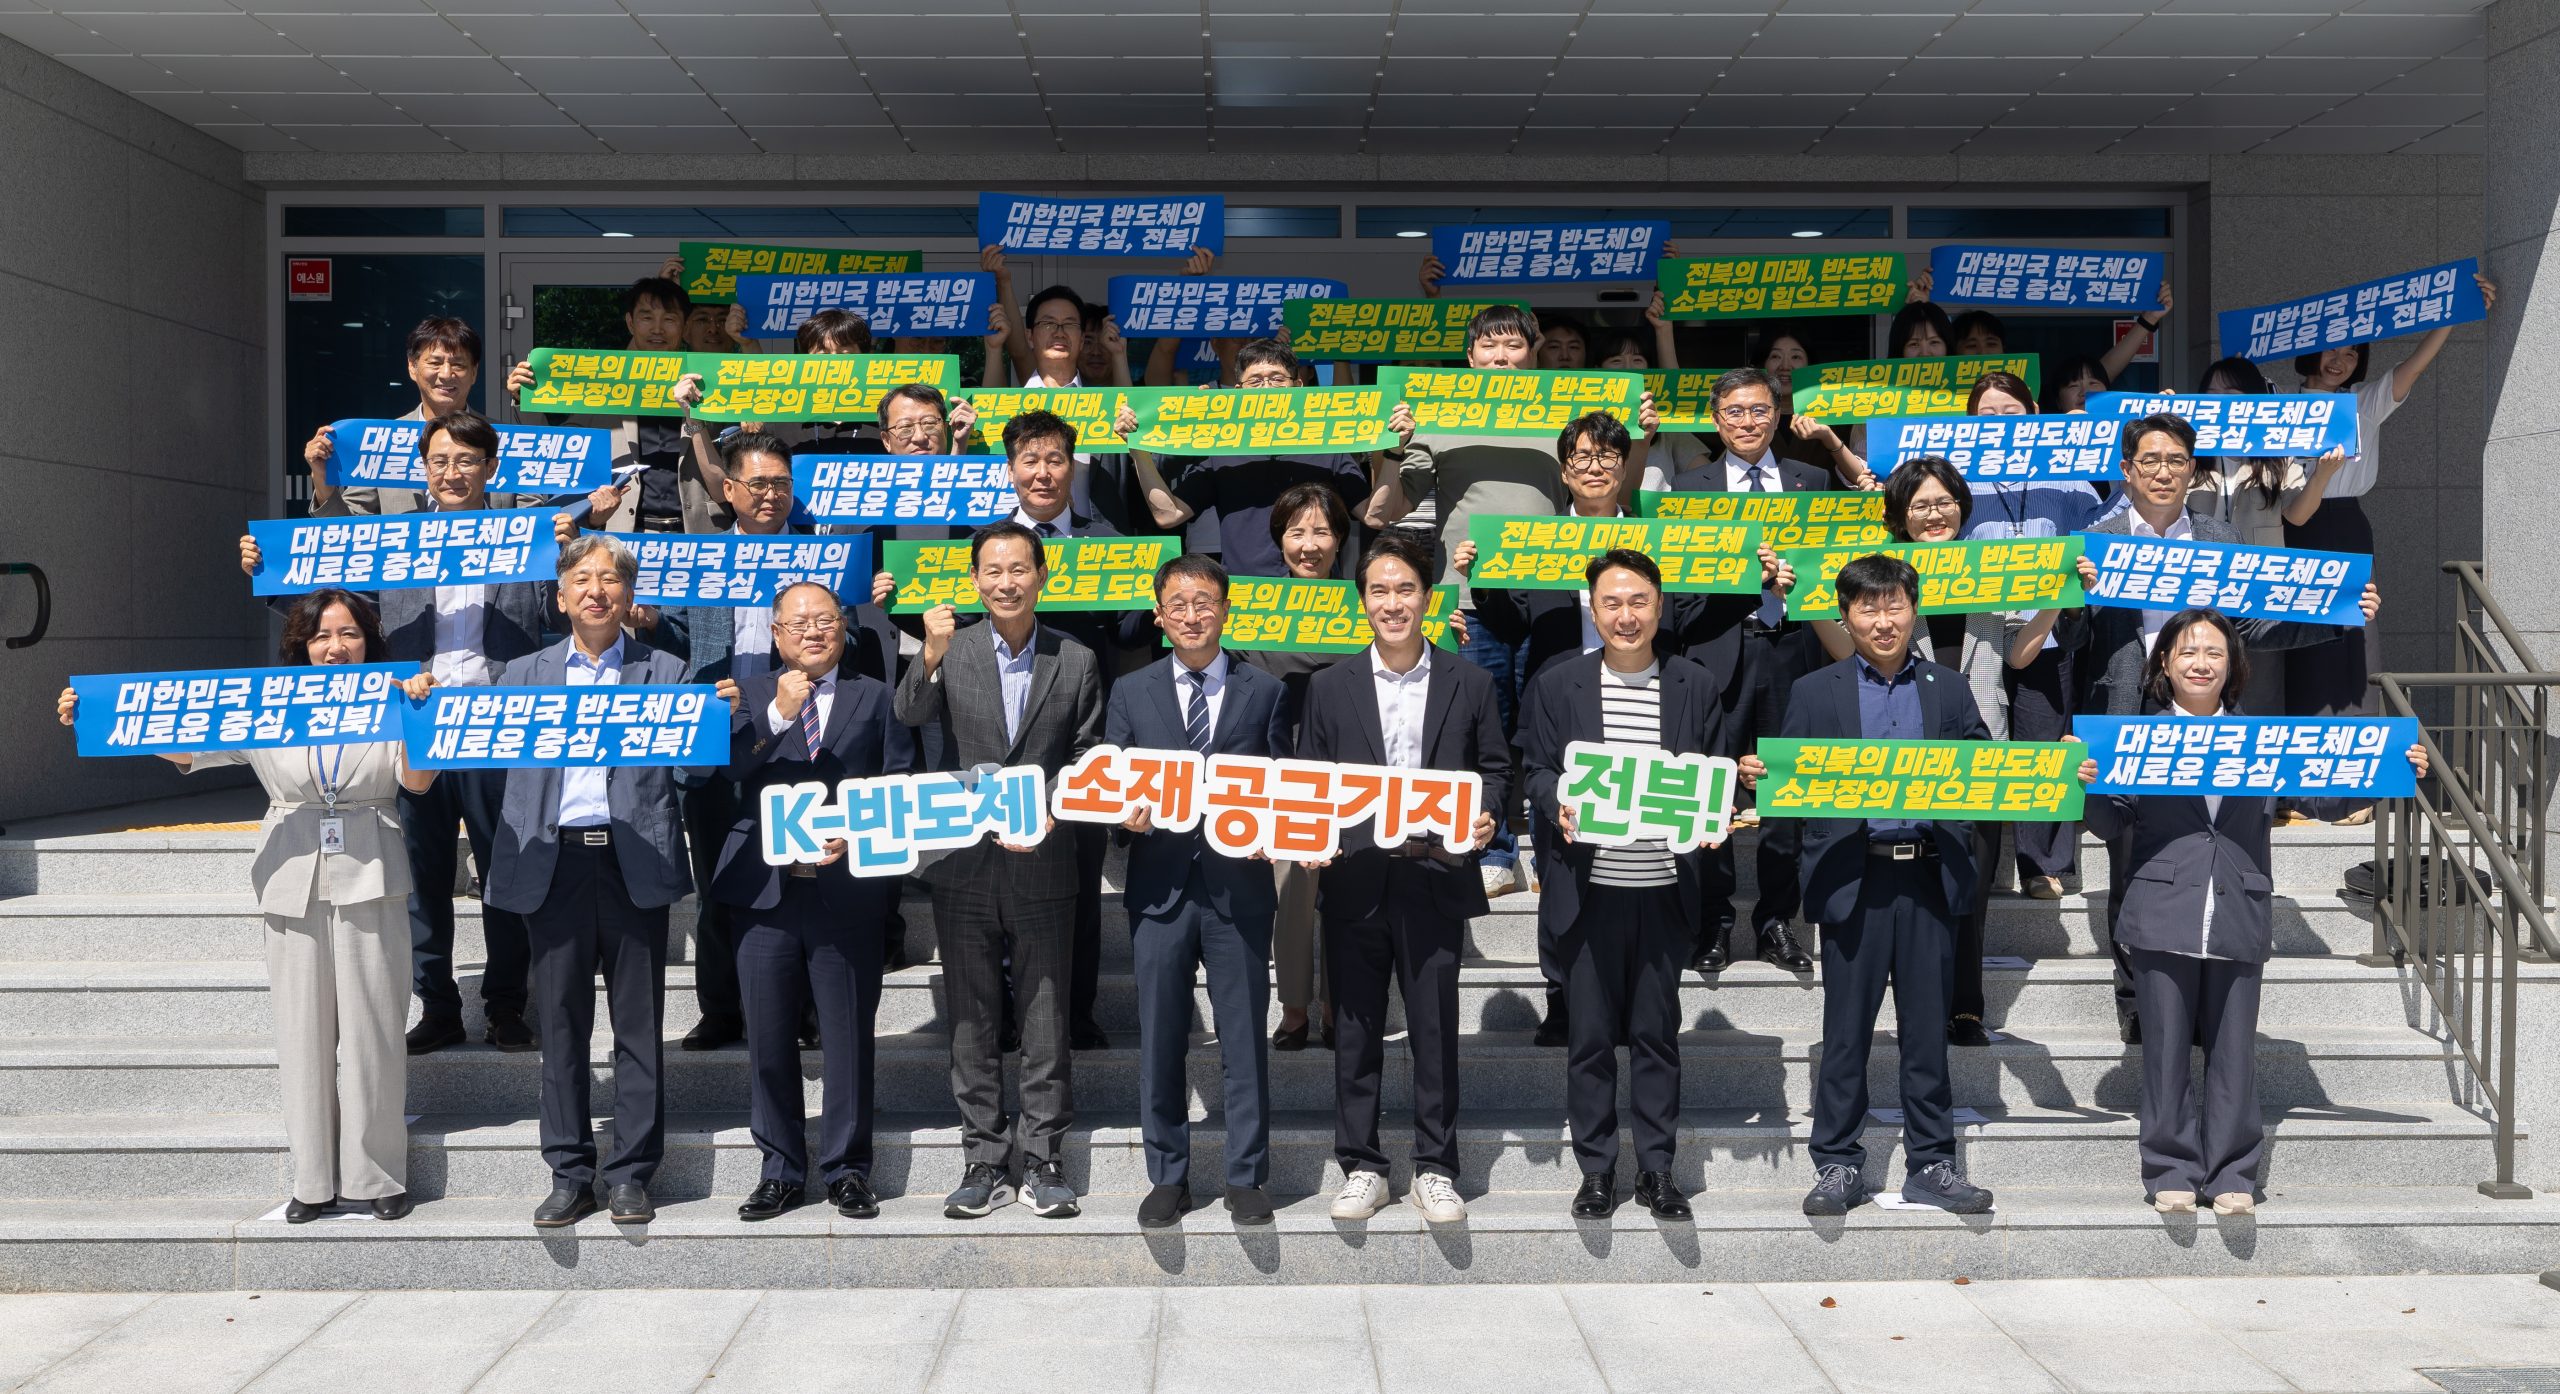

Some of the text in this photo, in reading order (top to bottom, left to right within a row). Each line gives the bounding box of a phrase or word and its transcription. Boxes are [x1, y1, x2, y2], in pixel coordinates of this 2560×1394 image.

[1007, 202, 1205, 226] 대한민국 반도체의
[999, 226, 1199, 253] 새로운 중심, 전북!
[1460, 227, 1652, 254] 대한민국 반도체의
[705, 249, 776, 274] 전북의
[837, 255, 908, 274] 반도체
[1453, 251, 1646, 279] 새로운 중심, 전북!
[1686, 257, 1893, 286] 전북의 미래, 반도체
[1956, 252, 2148, 280] 대한민국 반도체의
[296, 272, 325, 284] 에스원
[688, 275, 737, 297] 소부
[768, 279, 975, 306] 대한민국 반도체의
[1950, 277, 2141, 304] 새로운 중심, 전북!
[1131, 282, 1229, 305] 대한민국
[1670, 283, 1896, 312] 소부장의 힘으로 도약
[2250, 268, 2457, 335] 대한민국 반도체의
[762, 305, 969, 334] 새로 심, 전북!
[1124, 307, 1197, 330] 새로운
[1204, 307, 1258, 334] 중심,
[1309, 303, 1382, 327] 전북의
[1387, 304, 1436, 331] 미래,
[2244, 294, 2454, 359] 새로운 중심, 전북!
[1292, 330, 1469, 352] 소부장의 힘으로
[549, 355, 626, 380] 전북의
[717, 360, 945, 388] 전북의 미래, 반도체
[1819, 364, 1892, 391] 전북의
[1896, 361, 1948, 389] 미래,
[531, 381, 635, 407] 소부장의
[700, 389, 806, 414] 소부장의
[1405, 373, 1630, 404] 전북의 미래, 반도체
[1644, 374, 1720, 400] 래, 반도
[1048, 393, 1106, 420] 미래,
[1157, 395, 1235, 421] 전북의
[1238, 393, 1297, 422] 미래,
[1303, 391, 1382, 417] 반도체
[1410, 401, 1491, 428] 부장의
[1494, 403, 1572, 429] 힘으로
[1655, 400, 1697, 424] 으로
[1804, 391, 1900, 417] 소부장의
[2227, 400, 2335, 425] 반도체의
[359, 427, 591, 460] 대한 도체의
[1139, 423, 1246, 448] 소부장의
[1249, 420, 1327, 446] 힘으로
[1328, 420, 1385, 444] 도약
[1898, 420, 2120, 449] 대한민국 반도체의
[2194, 427, 2328, 453] 중심, 전북!
[517, 461, 584, 488] 전북!
[811, 462, 1011, 490] 대한민국 반도체
[1978, 450, 2037, 479] 중심,
[2048, 448, 2112, 474] 전북!
[803, 491, 1019, 521] 새로운 중심, 전북
[1656, 497, 1884, 527] 전북의 미래, 반도체
[290, 516, 536, 554] 대한민국 반도체의
[1500, 521, 1748, 553] 전북의 미래, 반도체
[283, 546, 531, 585] 새로운 중심, 전북!
[733, 543, 851, 571] 반도체의
[915, 547, 972, 574] 전북
[1077, 543, 1162, 572] 반도체
[1686, 557, 1748, 585] 도약
[1911, 546, 1974, 576] 미래,
[1979, 543, 2065, 571] 반도체
[2101, 543, 2350, 587] 대한민국 반도체의
[634, 571, 690, 599] 로운
[697, 572, 762, 604] 중심,
[897, 577, 981, 605] 소부장
[1037, 575, 1099, 602] 으로
[1228, 583, 1283, 611] 북의
[1285, 585, 1346, 617] 미래,
[1920, 573, 2067, 607] 힘으로 도약
[2089, 571, 2338, 615] 새로운 중심, 전북!
[1222, 613, 1291, 642] 장의
[115, 671, 392, 713] 대한민국 반도체의
[434, 693, 706, 727] 대한민국 반도체의
[107, 703, 386, 747] 새로운 중심, 전북!
[427, 726, 698, 763] 새로운 중심, 전북!
[2114, 725, 2390, 757] 대한민국 반도체의
[1794, 746, 2067, 782] 전북의 미래, 반도체
[2104, 757, 2380, 792] 새로운 중심, 전북!
[771, 752, 1727, 867] K-반도체 소재 공급기지 전북!
[1771, 779, 2068, 812] 소부장의 힘으로 도약
